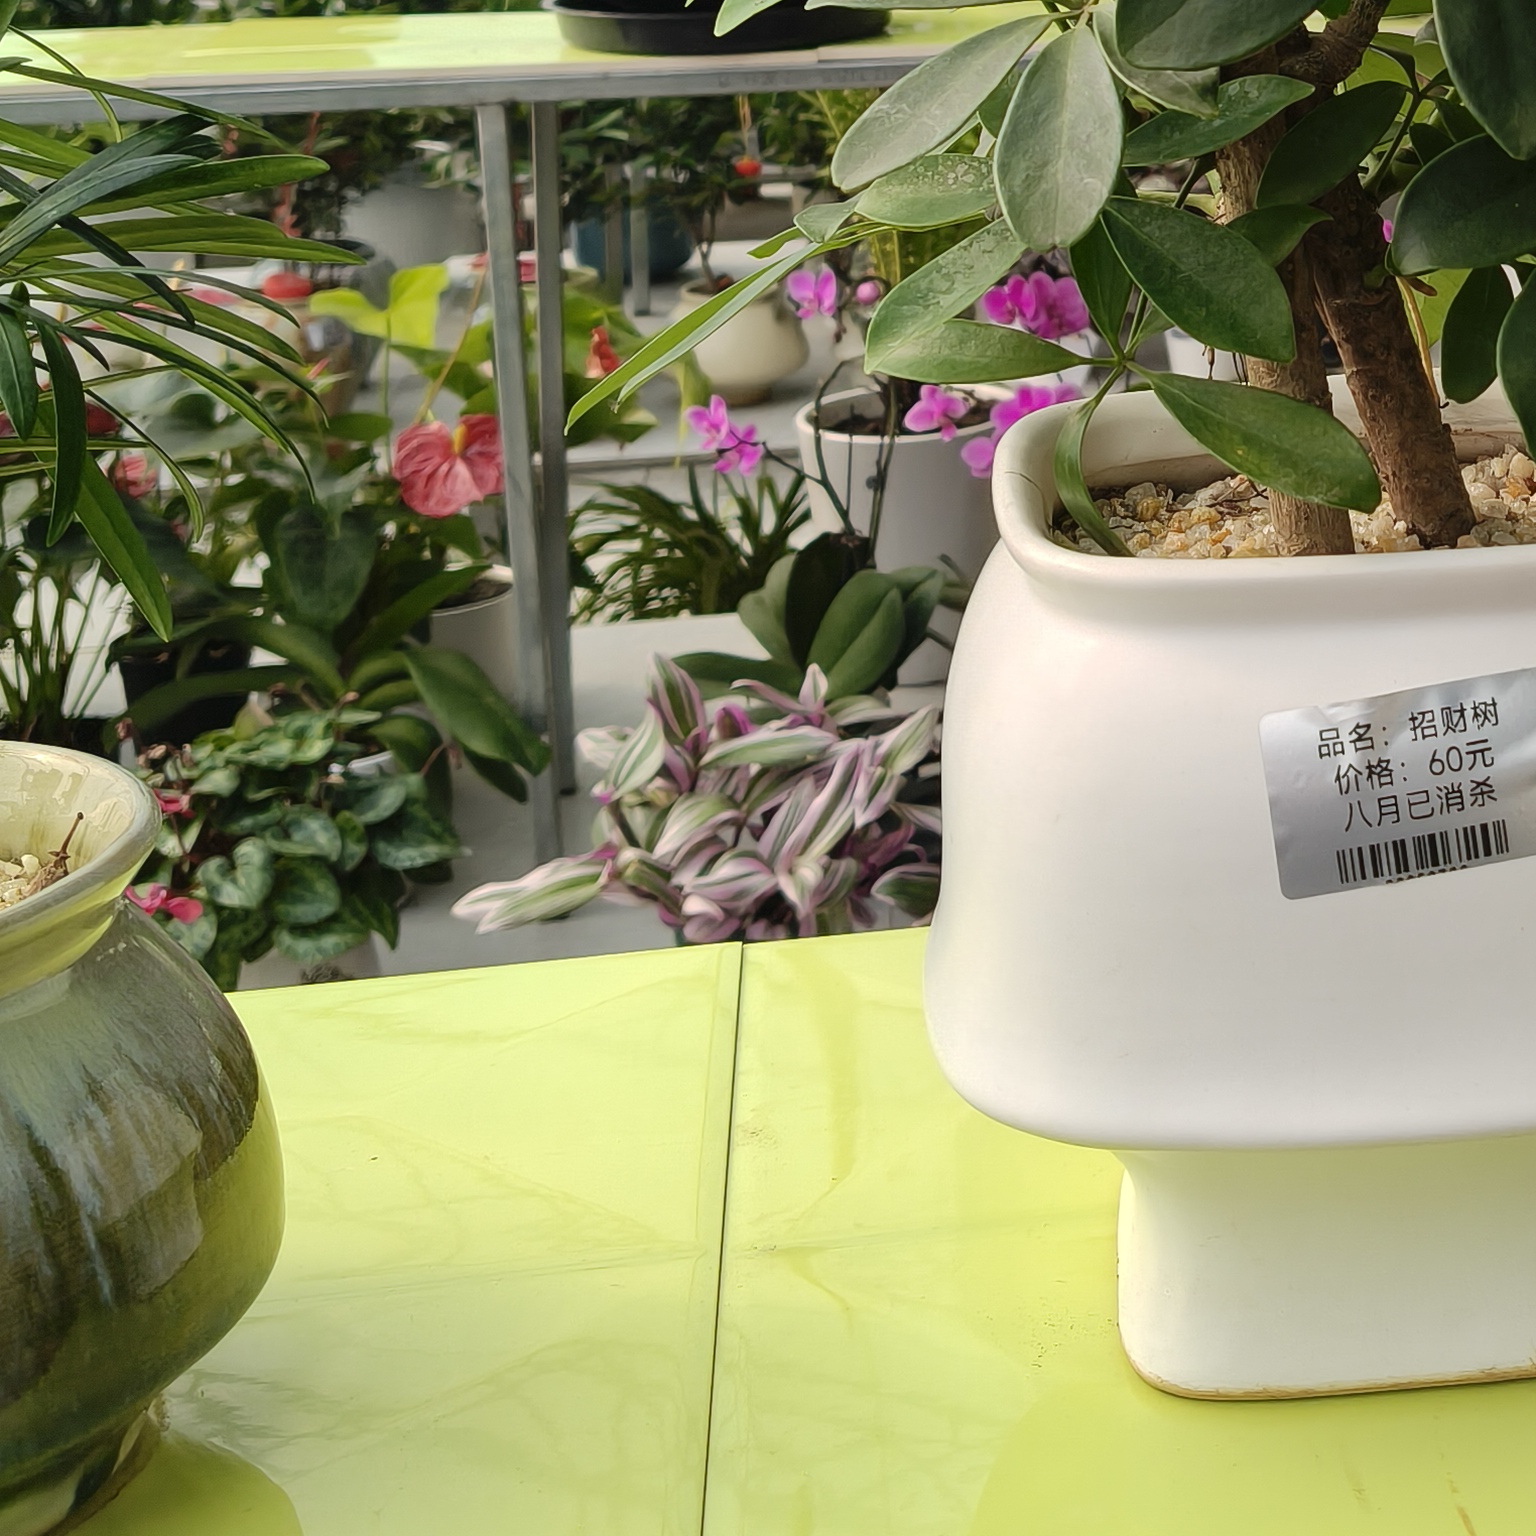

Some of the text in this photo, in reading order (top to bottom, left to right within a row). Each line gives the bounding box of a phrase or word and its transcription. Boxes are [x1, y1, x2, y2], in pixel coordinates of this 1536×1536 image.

[1317, 697, 1499, 759] 品名：招财树
[1334, 739, 1495, 795] 价格：60元
[1344, 776, 1498, 832] 八月已消杀
